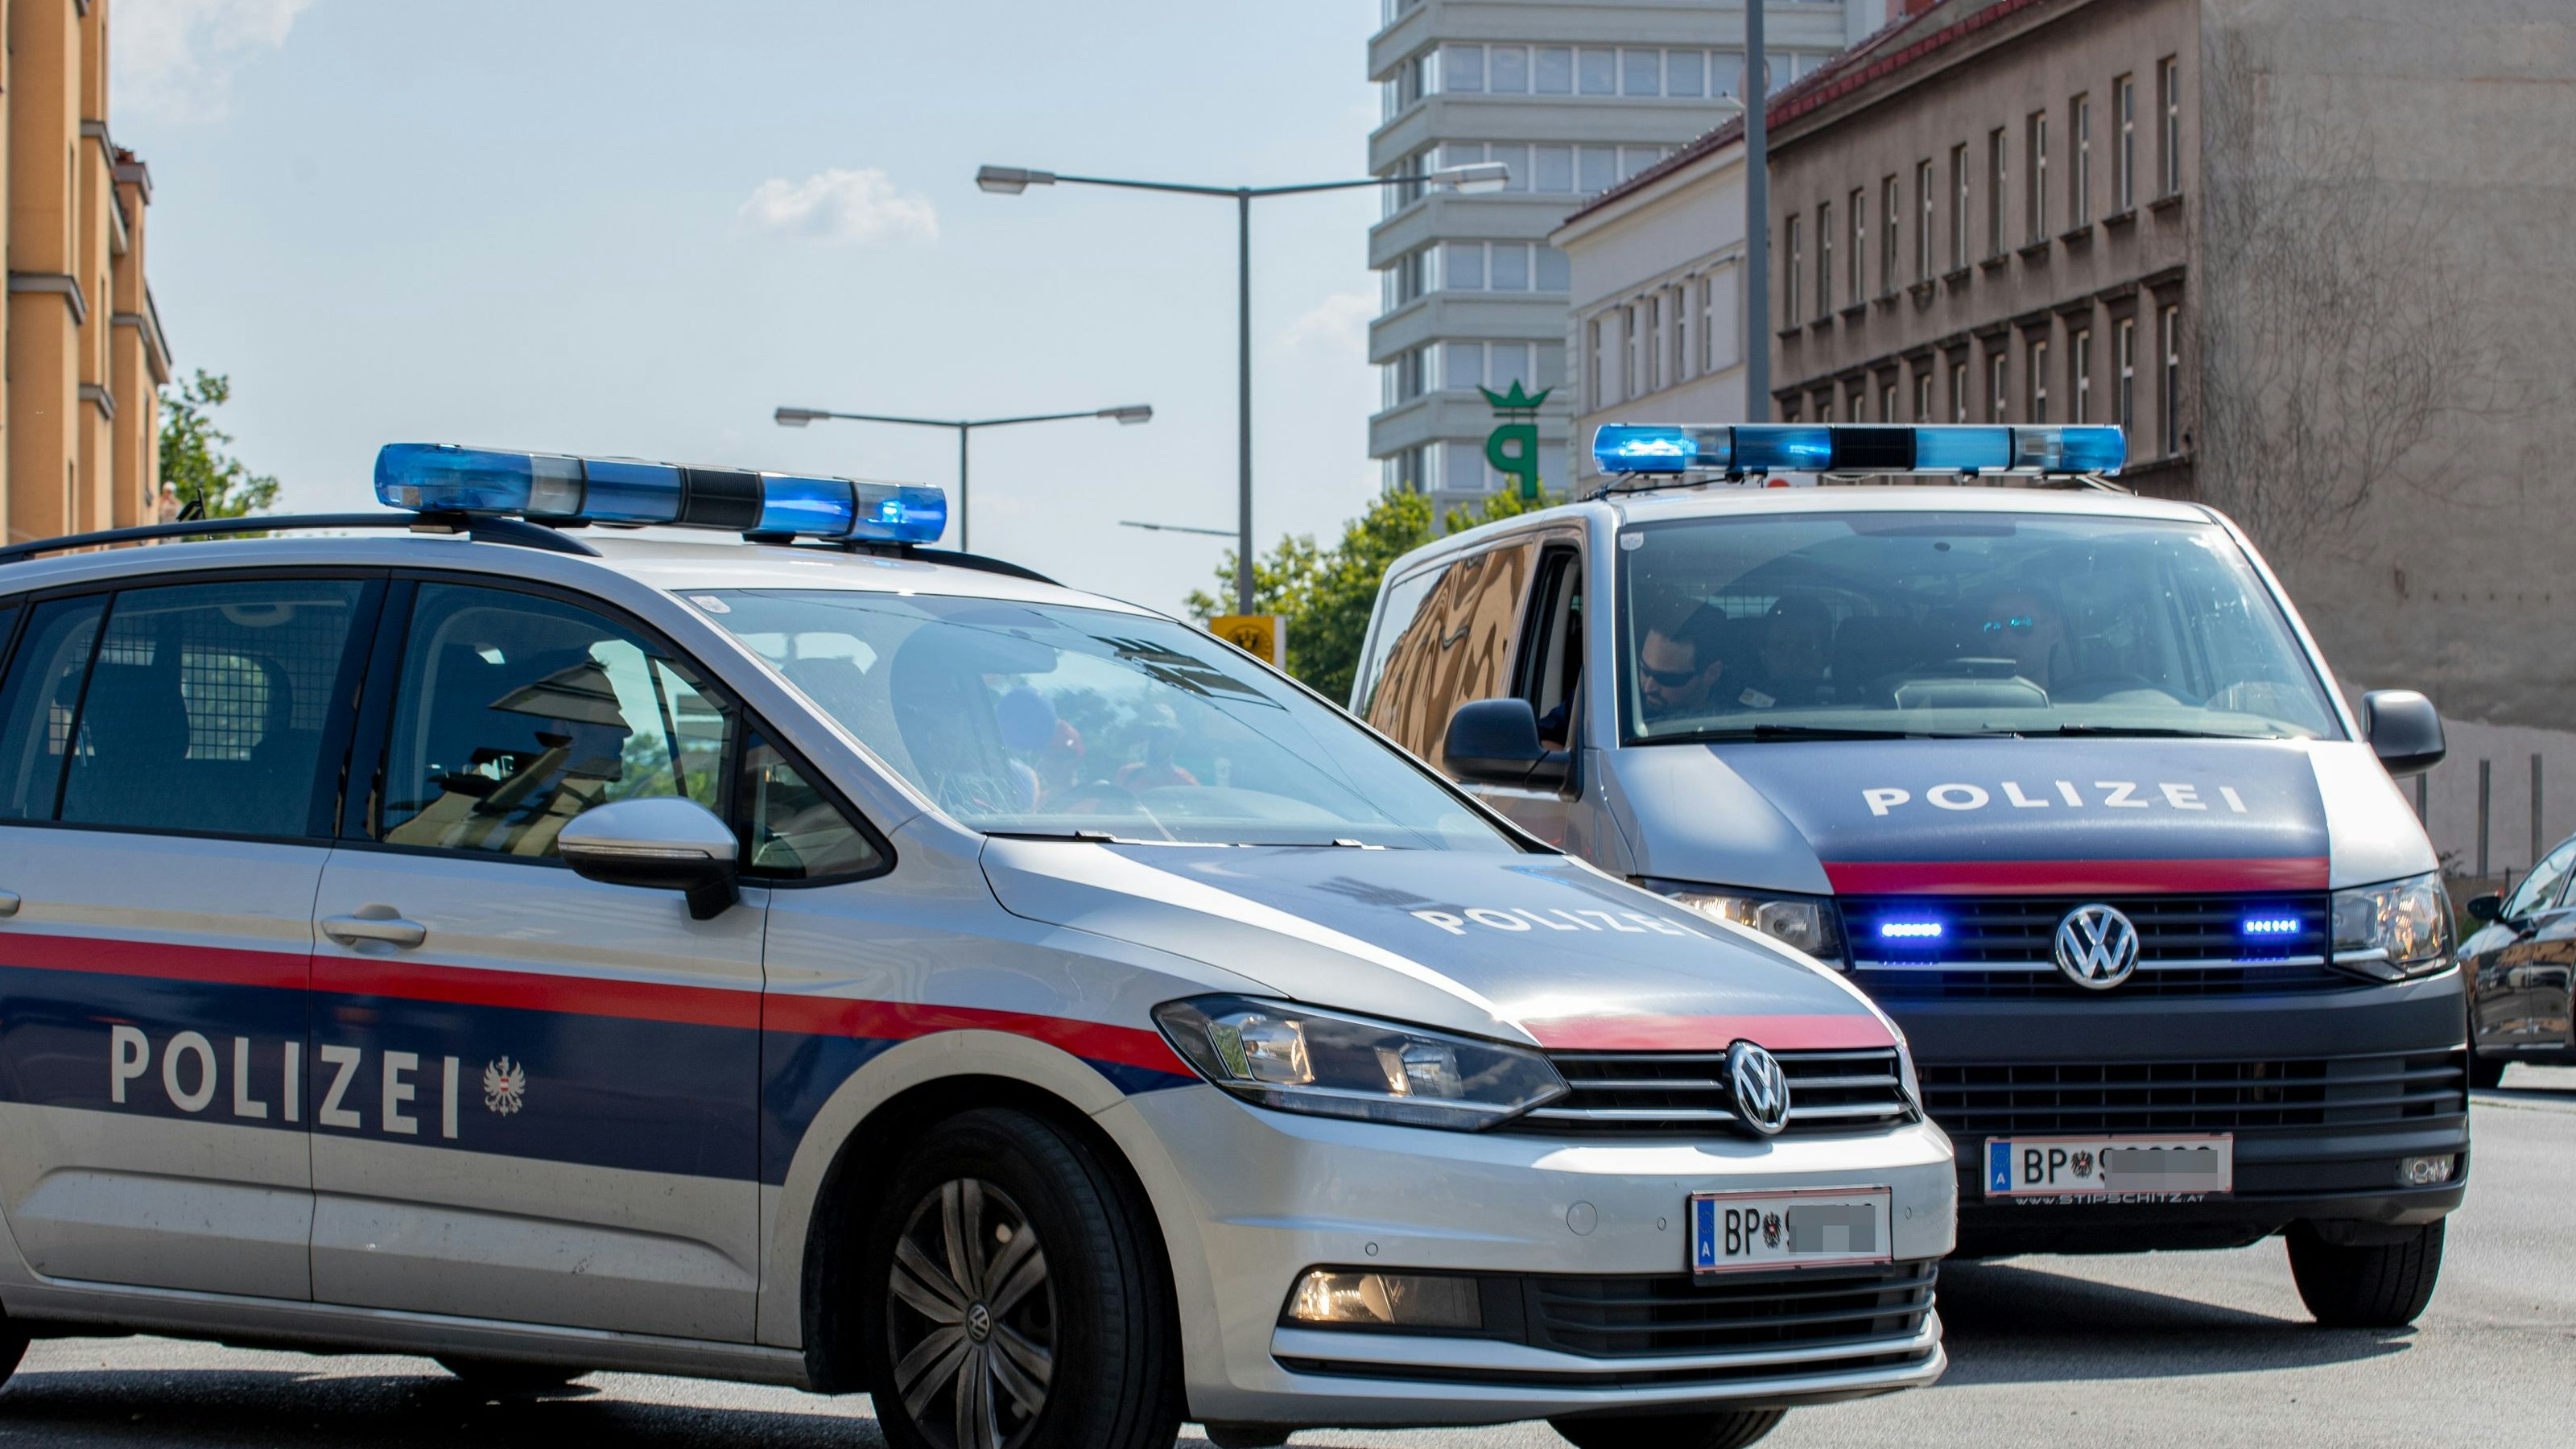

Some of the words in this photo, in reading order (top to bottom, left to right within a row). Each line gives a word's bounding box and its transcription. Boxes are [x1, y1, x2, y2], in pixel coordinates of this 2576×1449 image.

[1862, 779, 2248, 816] POLIZEI
[1410, 907, 1711, 936] POLIZEI
[2054, 902, 2140, 990] VW
[110, 1025, 459, 1139] POLIZEI
[2025, 1148, 2067, 1184] BP
[1701, 1241, 1711, 1257] A
[1725, 1208, 1760, 1256] BP
